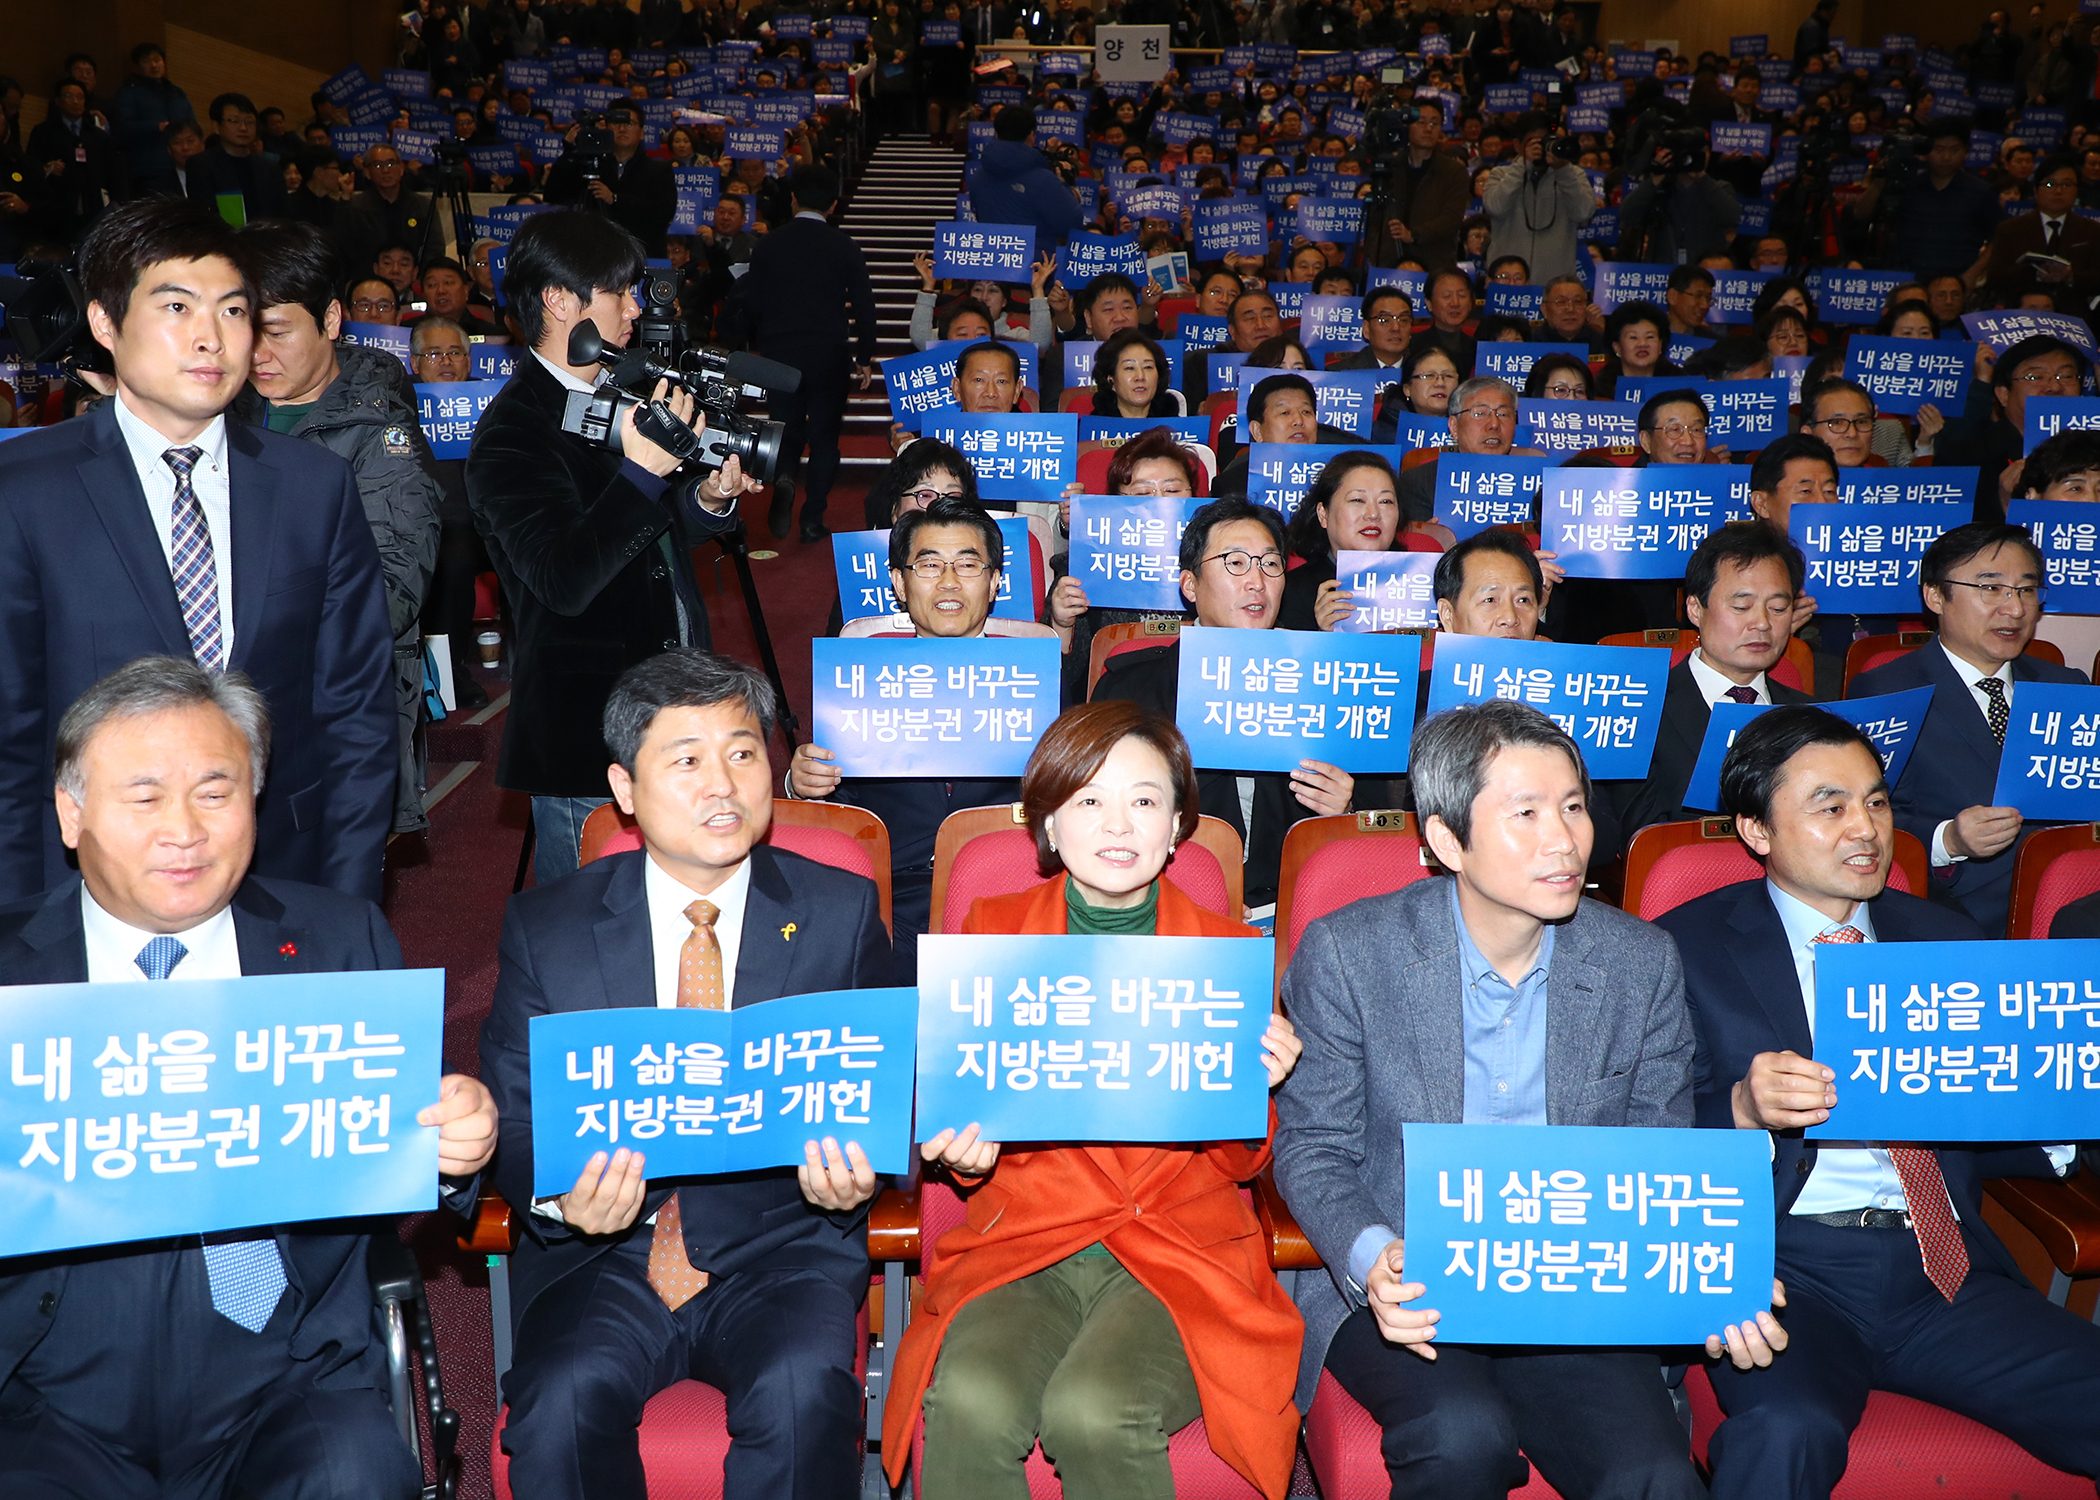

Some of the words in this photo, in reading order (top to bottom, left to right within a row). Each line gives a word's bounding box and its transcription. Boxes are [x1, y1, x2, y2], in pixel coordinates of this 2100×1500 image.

[1104, 39, 1124, 61] 양
[1142, 39, 1159, 60] 천
[2059, 328, 2091, 348] 개헌
[1880, 352, 1913, 372] 삶을
[910, 366, 937, 388] 삶을
[438, 397, 472, 417] 삶을
[1408, 429, 1424, 448] 내
[2040, 415, 2060, 436] 내
[961, 430, 1000, 452] 삶을
[1007, 431, 1064, 453] 바꾸는
[1534, 432, 1597, 450] 지방분권
[1022, 458, 1059, 480] 개헌
[1263, 461, 1282, 483] 내
[1451, 471, 1470, 494] 내
[1476, 473, 1516, 496] 삶을
[1451, 500, 1529, 524] 지방분권
[1560, 490, 1582, 516] 내
[1591, 490, 1641, 517] 삶을
[1649, 490, 1714, 517] 바꾸는
[1086, 518, 1110, 545] 내
[1119, 520, 1168, 546] 삶을
[1561, 524, 1658, 551] 지방분권
[1807, 526, 1830, 552] 내
[1839, 526, 1885, 552] 삶을
[2051, 524, 2097, 551] 삶을
[852, 553, 877, 579] 내
[1809, 560, 1899, 587] 지방분권
[1353, 573, 1376, 600] 내
[835, 665, 864, 699] 내
[875, 664, 937, 699] 삶을
[947, 665, 1039, 699] 바꾸는
[1201, 656, 1231, 690] 내
[1241, 658, 1303, 693] 삶을
[1313, 661, 1400, 696] 바꾸는
[1454, 663, 1484, 697] 내
[1494, 667, 1555, 703] 삶을
[1565, 673, 1648, 707] 바꾸는
[840, 709, 962, 742] 지방분권
[973, 709, 1034, 742] 개헌
[1203, 701, 1325, 737] 지방분권
[1336, 705, 1391, 739] 개헌
[1583, 716, 1637, 748] 개헌
[2030, 712, 2061, 745] 내
[950, 977, 992, 1028] 내
[1008, 976, 1096, 1026] 삶을
[1112, 977, 1244, 1028] 바꾸는
[1847, 984, 1886, 1032] 내
[1901, 982, 1985, 1031] 삶을
[12, 1037, 72, 1101] 내
[93, 1030, 216, 1097] 삶을
[235, 1021, 405, 1086] 바꾸는
[567, 1045, 613, 1090] 내
[631, 1042, 729, 1085] 삶을
[744, 1026, 884, 1075] 바꾸는
[956, 1041, 1131, 1091] 지방분권
[1147, 1041, 1234, 1092] 개헌
[1850, 1044, 2018, 1094] 지방분권
[576, 1090, 763, 1143] 지방분권
[780, 1080, 871, 1124] 개헌
[19, 1105, 260, 1182] 지방분권
[281, 1094, 390, 1158] 개헌
[1439, 1169, 1483, 1223] 내
[1499, 1170, 1592, 1224] 삶을
[1607, 1172, 1744, 1226] 바꾸는
[1444, 1239, 1628, 1292] 지방분권
[1644, 1242, 1734, 1294] 개헌
